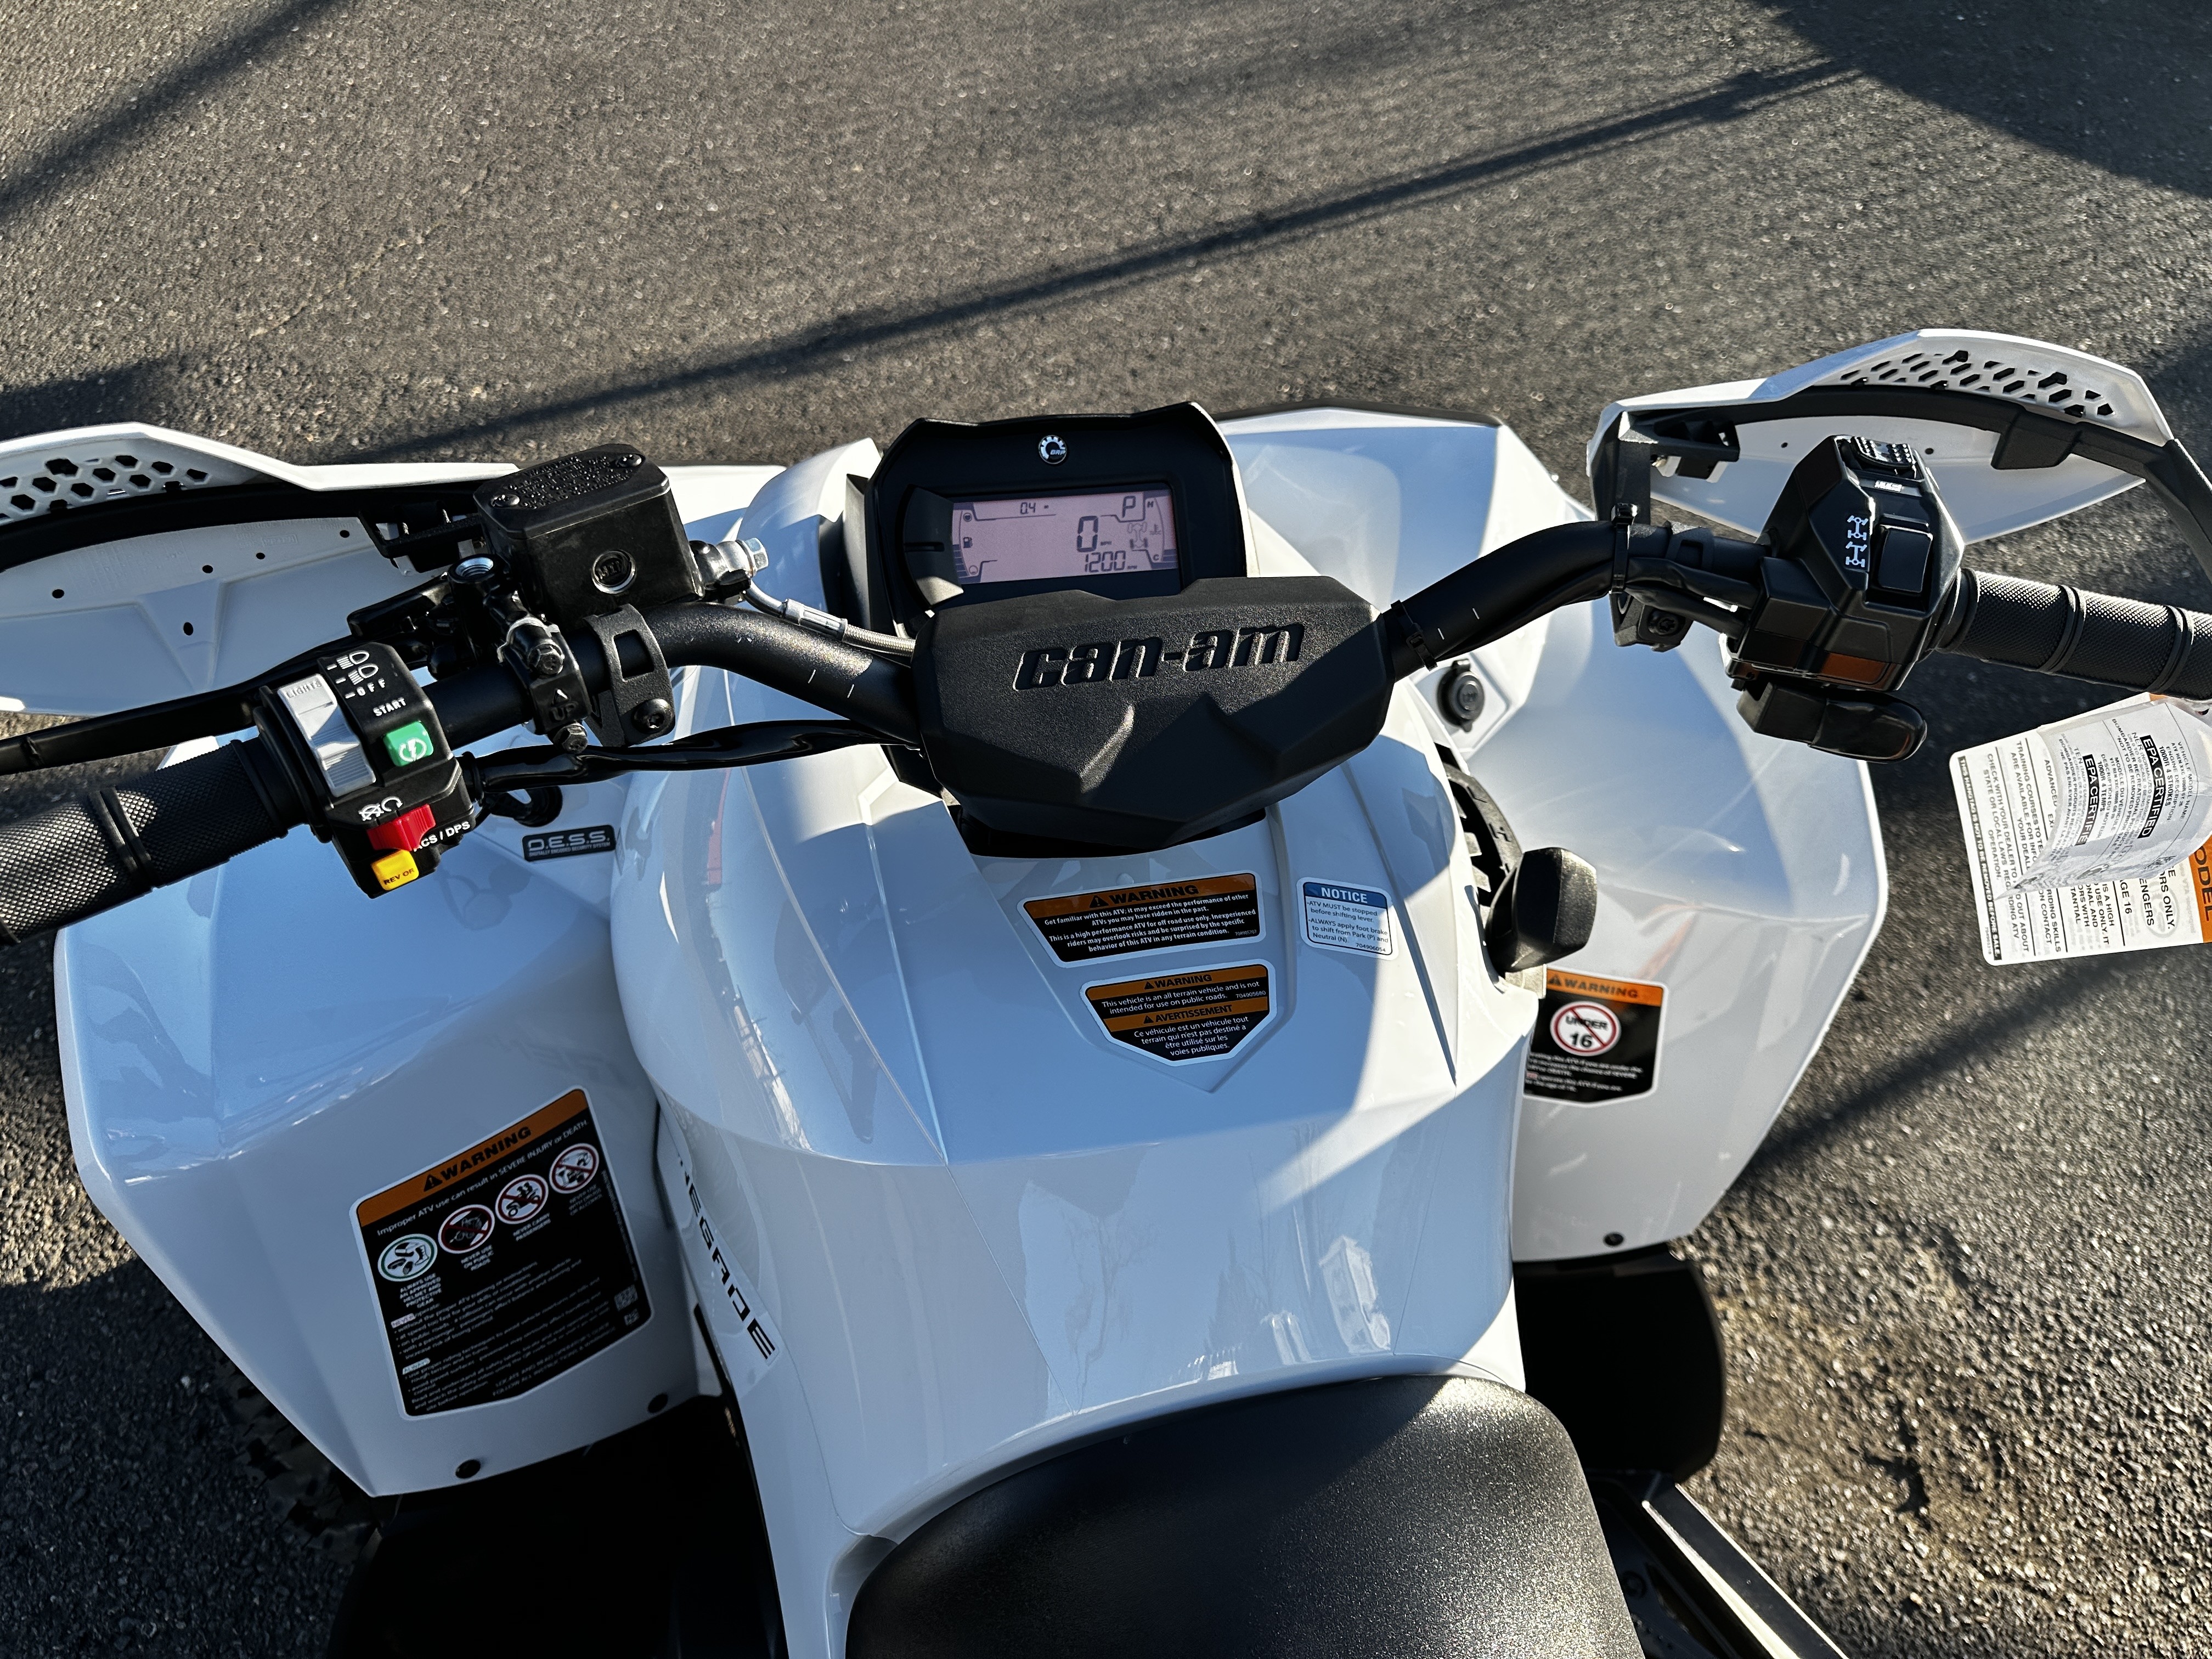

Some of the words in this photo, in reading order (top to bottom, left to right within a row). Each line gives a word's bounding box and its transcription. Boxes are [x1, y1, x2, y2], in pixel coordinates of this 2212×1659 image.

[1122, 496, 1136, 518] P
[1077, 515, 1099, 552] 0
[1084, 550, 1126, 573] 1200
[1014, 622, 1305, 692] can-am
[286, 679, 323, 699] LIGHTS
[373, 696, 406, 716] START
[2142, 738, 2159, 766] EPA
[1987, 753, 1999, 783] CHECK
[2085, 758, 2098, 785] EPA
[2097, 760, 2106, 781] 1000R
[2158, 745, 2170, 766] 1000R
[2164, 775, 2174, 806] STROKES
[1994, 783, 2004, 805] WITH
[2010, 752, 2019, 769] ARE
[2025, 822, 2034, 840] FOR
[2016, 740, 2030, 782] TRAINING
[2025, 783, 2039, 825] COURSES
[2034, 825, 2041, 838] TO
[2140, 766, 2164, 838] CERTIFIED
[1999, 805, 2008, 830] YOUR
[444, 821, 470, 837] DPS
[2017, 817, 2026, 841] YOUR
[527, 830, 610, 851] D.E.S.S.
[2004, 831, 2015, 865] DEALER
[383, 873, 400, 886] REV
[2010, 866, 2017, 878] TO
[1109, 884, 1199, 905] WARNING
[2195, 845, 2212, 922] ODEL
[1321, 887, 1368, 904] NOTICE
[2102, 883, 2108, 893] IS
[2105, 903, 2115, 926] HIGH
[2138, 878, 2154, 926] ENGERS
[1056, 915, 1082, 923] familiar
[1148, 902, 1170, 910] exceed
[1182, 897, 1223, 907] performance
[1310, 907, 1331, 916] before
[1331, 910, 1356, 921] shifting
[1322, 902, 1341, 910] MUST
[1351, 907, 1378, 916] stopped
[2016, 901, 2024, 919] OUT
[2081, 904, 2090, 927] WITH
[2090, 908, 2098, 927] AND
[2095, 888, 2103, 906] USE
[2102, 936, 2109, 944] IT
[2124, 901, 2132, 914] 16
[2163, 895, 2175, 929] ONLY.
[2040, 903, 2052, 944] CONTACT
[2046, 888, 2056, 919] RIDING
[2051, 921, 2061, 952] SKILLS
[1312, 932, 1336, 941] Neutral
[1335, 928, 1351, 936] from
[1370, 927, 1388, 936] brake
[2019, 922, 2029, 952] ABOUT
[1154, 974, 1212, 988] WARNING
[1565, 979, 1639, 998] WARNING
[1118, 996, 1144, 1005] vehicle
[1198, 985, 1223, 994] vehicle
[1181, 996, 1204, 1005] public
[1155, 1004, 1233, 1023] AVERTISSEMENT
[1141, 1035, 1166, 1044] terrain
[1167, 1032, 1180, 1041] qui
[1212, 1024, 1240, 1034] destiné
[1144, 1025, 1176, 1036] véhicule
[1200, 1018, 1232, 1028] véhicule
[1181, 1037, 1203, 1046] utilisé
[1190, 1043, 1229, 1054] publiques.
[1570, 1033, 1594, 1048] 16
[441, 1126, 532, 1179] WARNING
[376, 1214, 416, 1236] Improper
[418, 1204, 433, 1217] ATV
[435, 1198, 449, 1208] use
[450, 1189, 465, 1200] can
[466, 1177, 488, 1192] result
[498, 1155, 526, 1175] SEVERE
[527, 1139, 552, 1159] INJURY
[554, 1135, 562, 1143] or
[685, 1171, 776, 1359] EGADE
